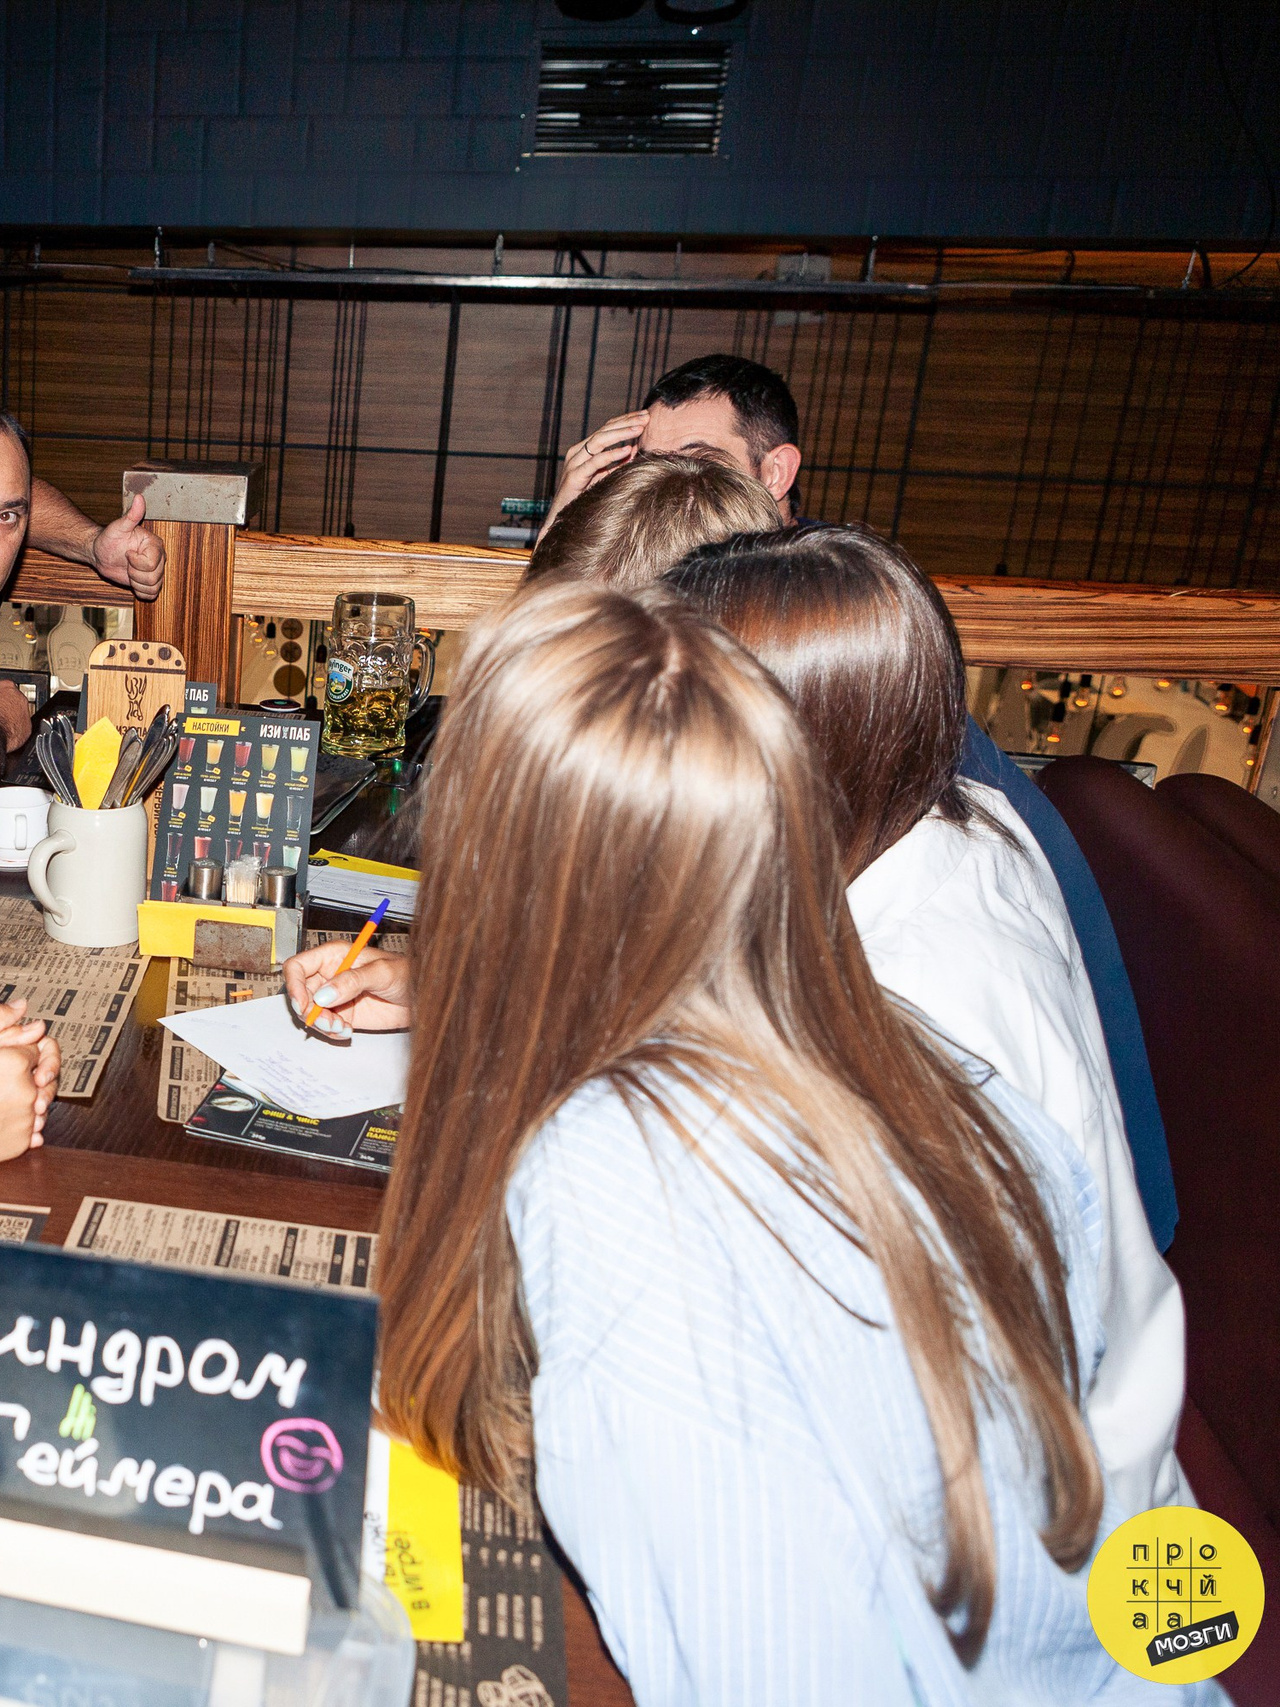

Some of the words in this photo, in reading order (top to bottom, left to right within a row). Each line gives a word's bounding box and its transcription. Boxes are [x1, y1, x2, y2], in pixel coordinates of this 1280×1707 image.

[329, 660, 352, 674] yinger
[189, 688, 209, 702] ПАБ
[192, 722, 230, 733] НАСТОЙКИ
[259, 724, 281, 738] ИЗИ
[289, 726, 311, 741] ПАБ
